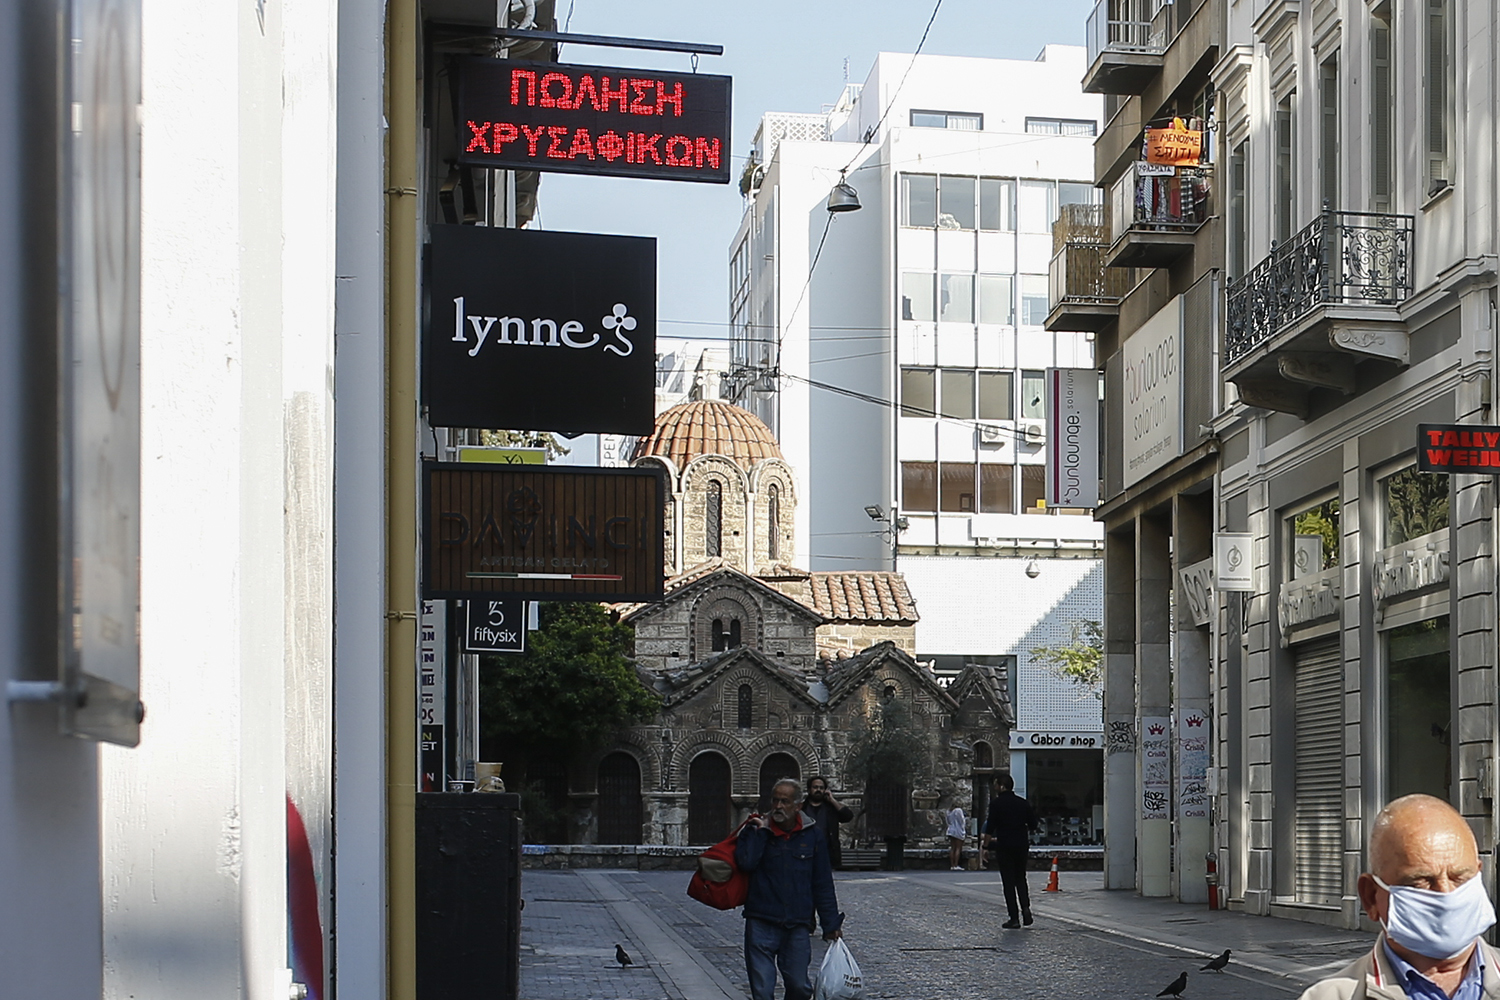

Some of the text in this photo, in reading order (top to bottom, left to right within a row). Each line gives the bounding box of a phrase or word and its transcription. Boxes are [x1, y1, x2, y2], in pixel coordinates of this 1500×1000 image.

[509, 68, 684, 117] ΠΩΛΗΣΗ
[466, 120, 722, 170] ΧΡΥΣΑΦΙΚΩΝ
[1154, 146, 1192, 160] ΣΠΙΤΙ
[452, 296, 600, 359] lynne
[1066, 369, 1074, 410] solarium
[1133, 395, 1168, 442] solarium
[1427, 430, 1500, 448] TALLY
[479, 556, 610, 569] ARTISAN GELATO
[474, 626, 517, 646] fiftysix
[1030, 733, 1096, 747] Gabor shop
